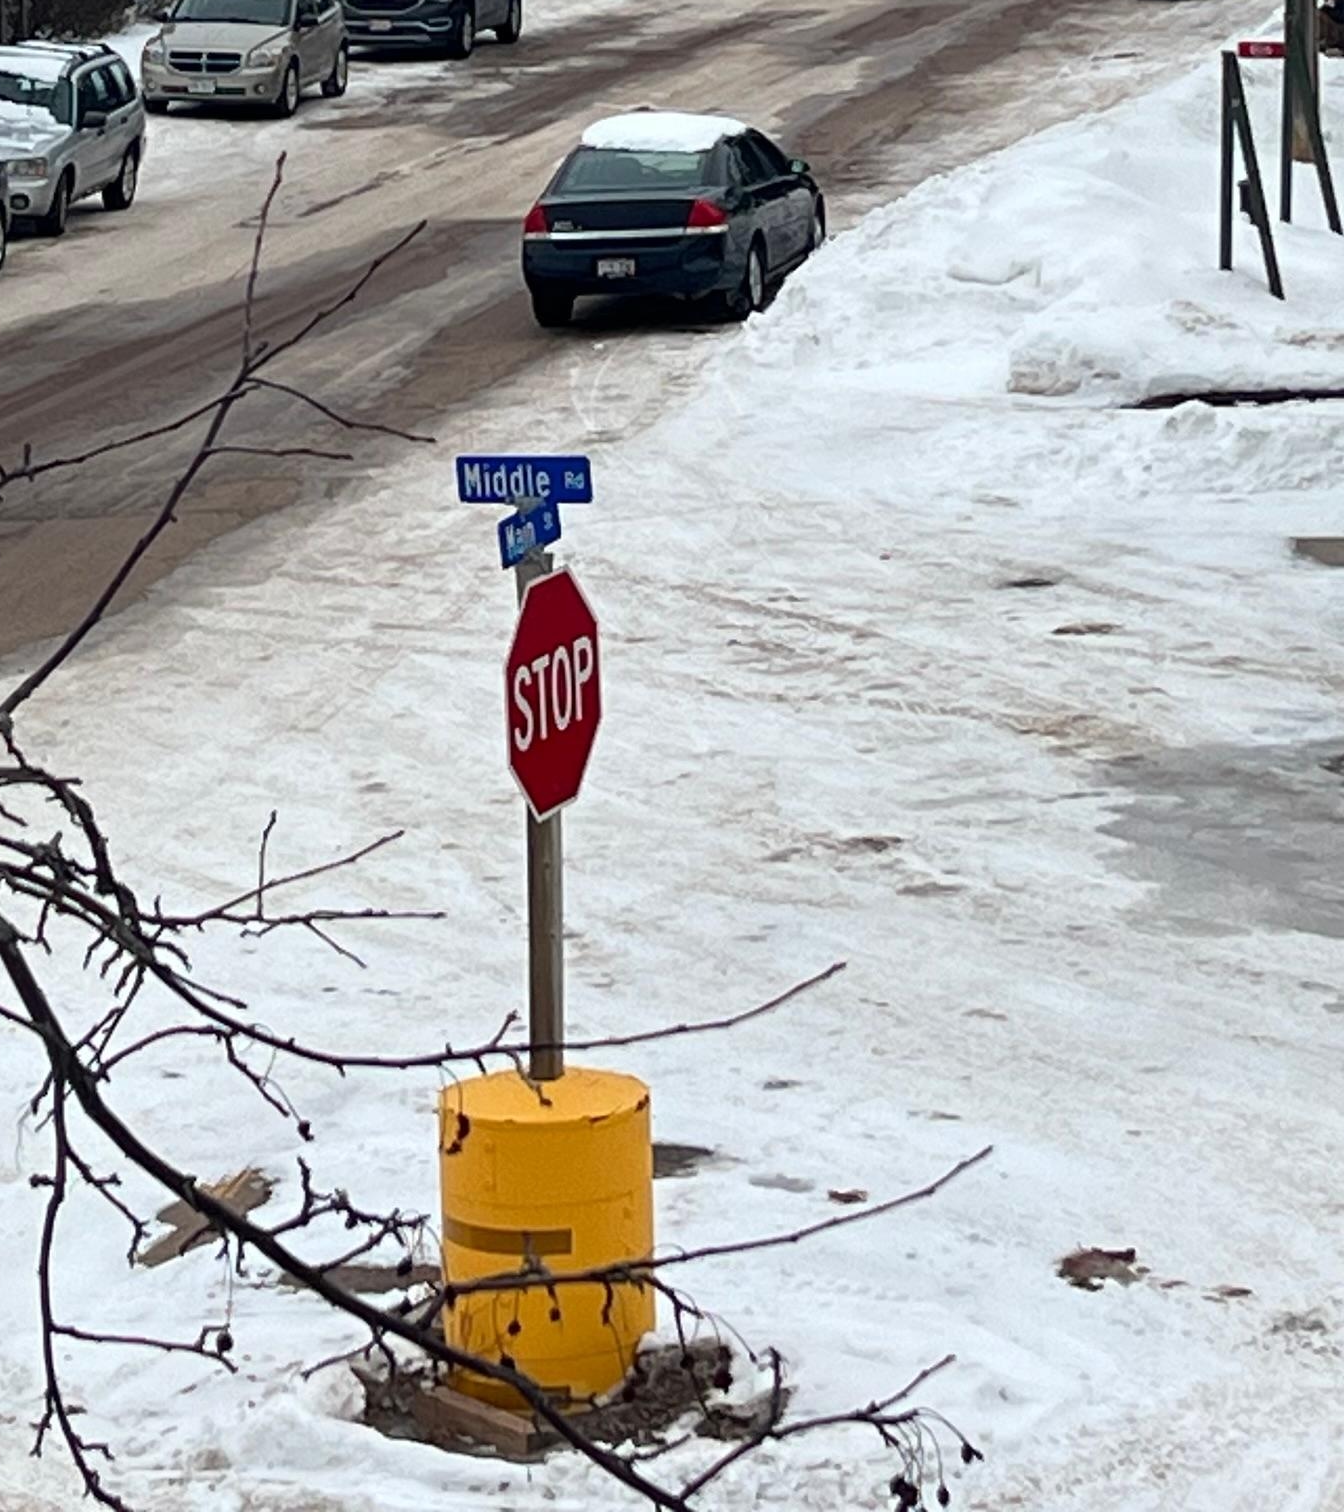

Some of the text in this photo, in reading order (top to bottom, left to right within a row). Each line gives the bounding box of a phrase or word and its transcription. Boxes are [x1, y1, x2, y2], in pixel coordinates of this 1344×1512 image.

[463, 462, 585, 498] Middle Rd
[505, 514, 537, 561] Main
[514, 636, 594, 752] STOP
